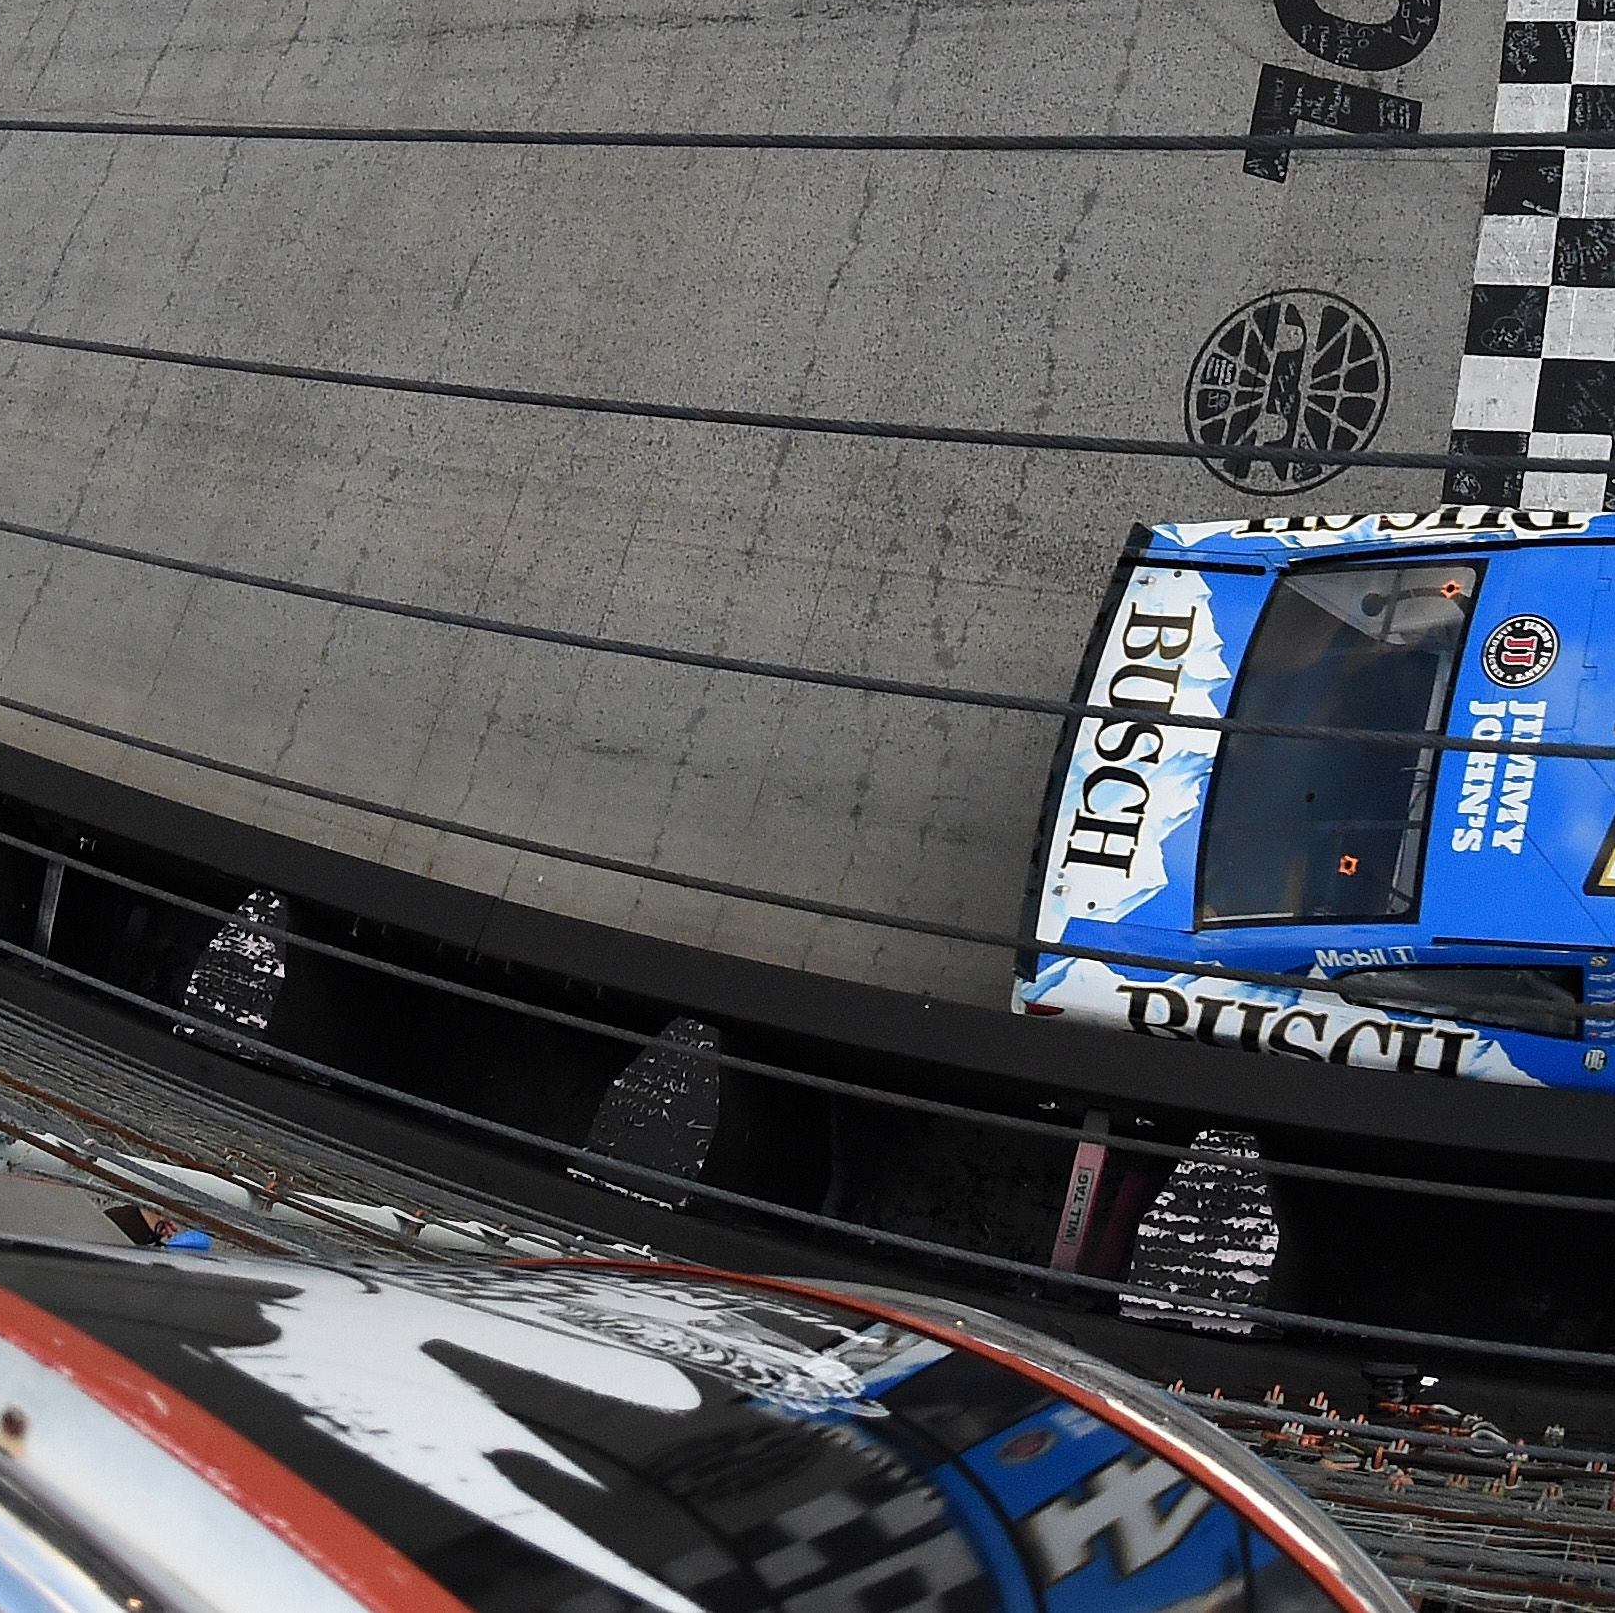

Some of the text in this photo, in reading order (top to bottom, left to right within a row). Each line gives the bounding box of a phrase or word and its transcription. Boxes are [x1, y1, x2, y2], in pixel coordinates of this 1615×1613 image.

[1062, 604, 1193, 880] BUSCH
[1451, 700, 1507, 852] JOHN'S
[1492, 700, 1547, 855] JIMMY
[1315, 948, 1387, 969] Mobil
[1075, 1173, 1091, 1200] TAG
